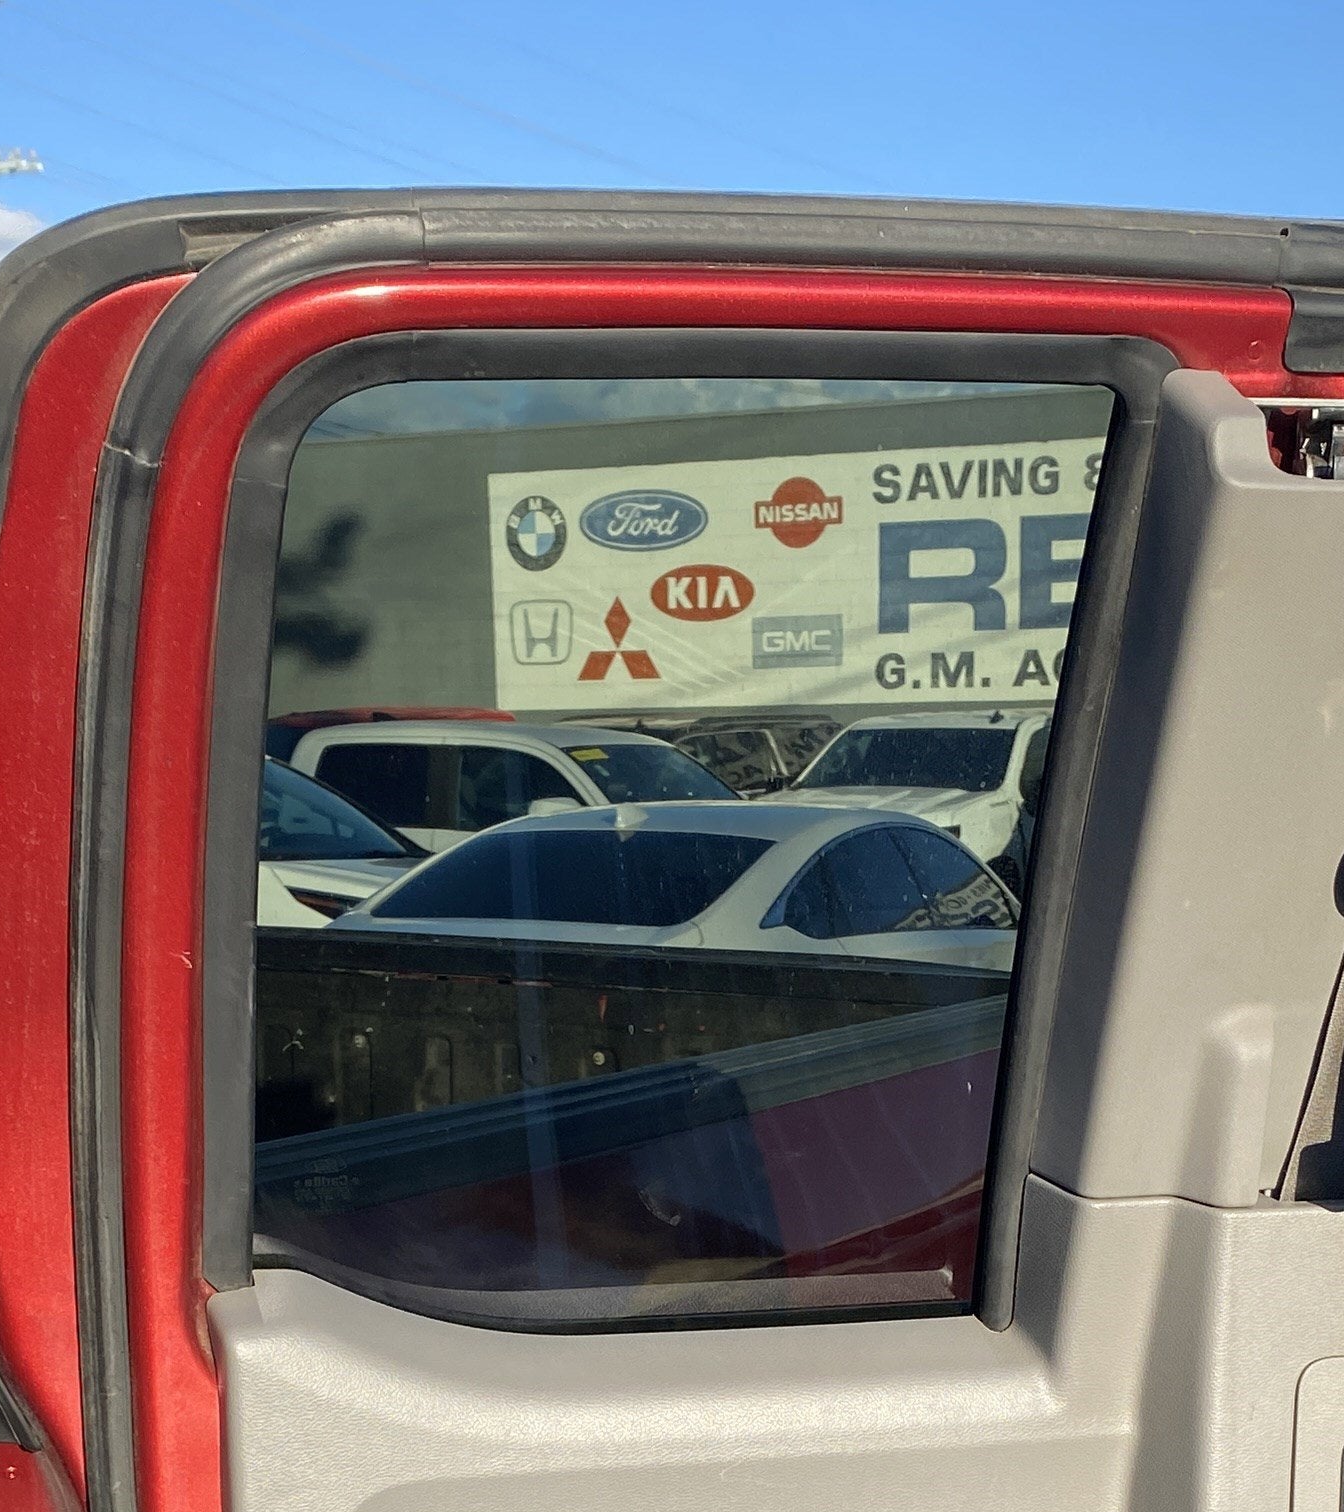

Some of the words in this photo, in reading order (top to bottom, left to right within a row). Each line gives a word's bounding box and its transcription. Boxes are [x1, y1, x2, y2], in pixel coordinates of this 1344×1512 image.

[872, 455, 1061, 504] SAVING
[606, 502, 679, 539] Ford
[758, 501, 840, 525] NISSAN
[666, 574, 740, 610] KIA
[761, 628, 833, 654] GMC
[874, 651, 991, 691] G.M.
